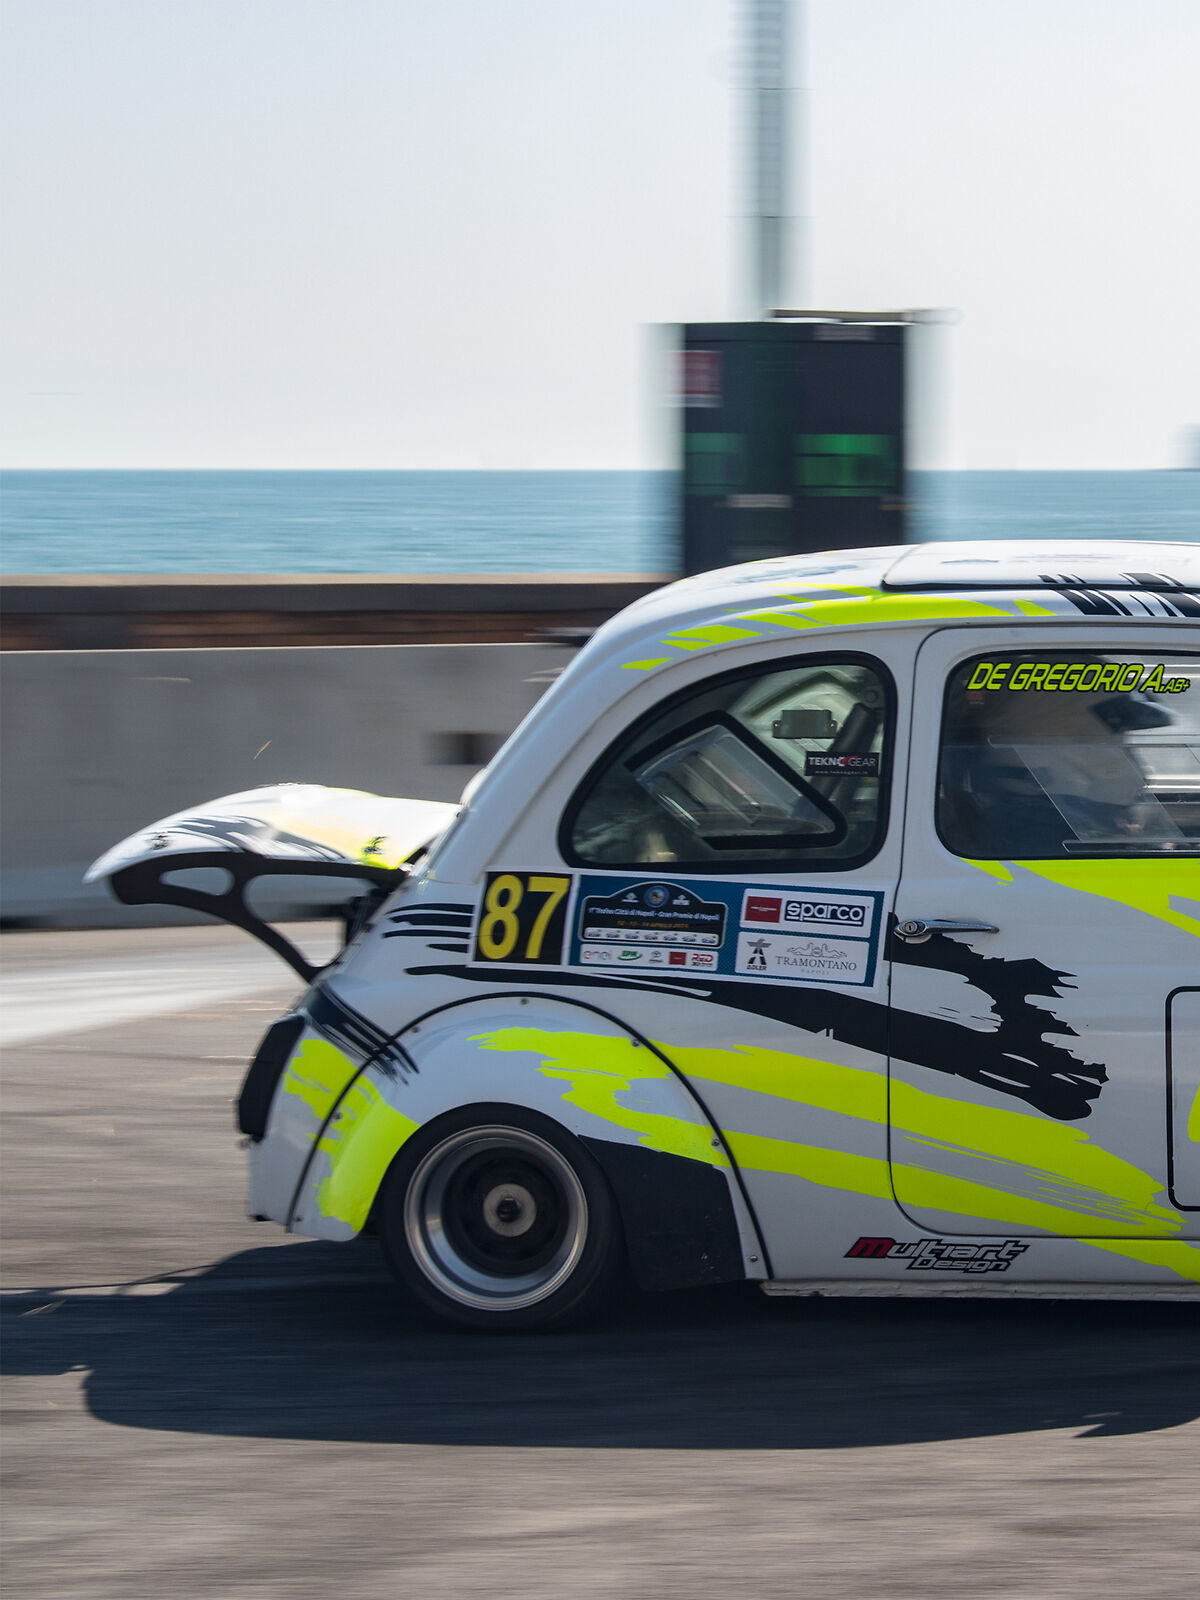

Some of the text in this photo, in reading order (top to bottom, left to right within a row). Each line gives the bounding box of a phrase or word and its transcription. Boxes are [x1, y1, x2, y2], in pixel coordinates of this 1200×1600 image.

[967, 662, 1012, 690] DE
[1008, 663, 1144, 692] GREGORIO
[478, 874, 571, 960] 87
[786, 902, 864, 922] sparco
[775, 956, 857, 971] TRAMONTANO
[906, 1258, 1011, 1273] Design
